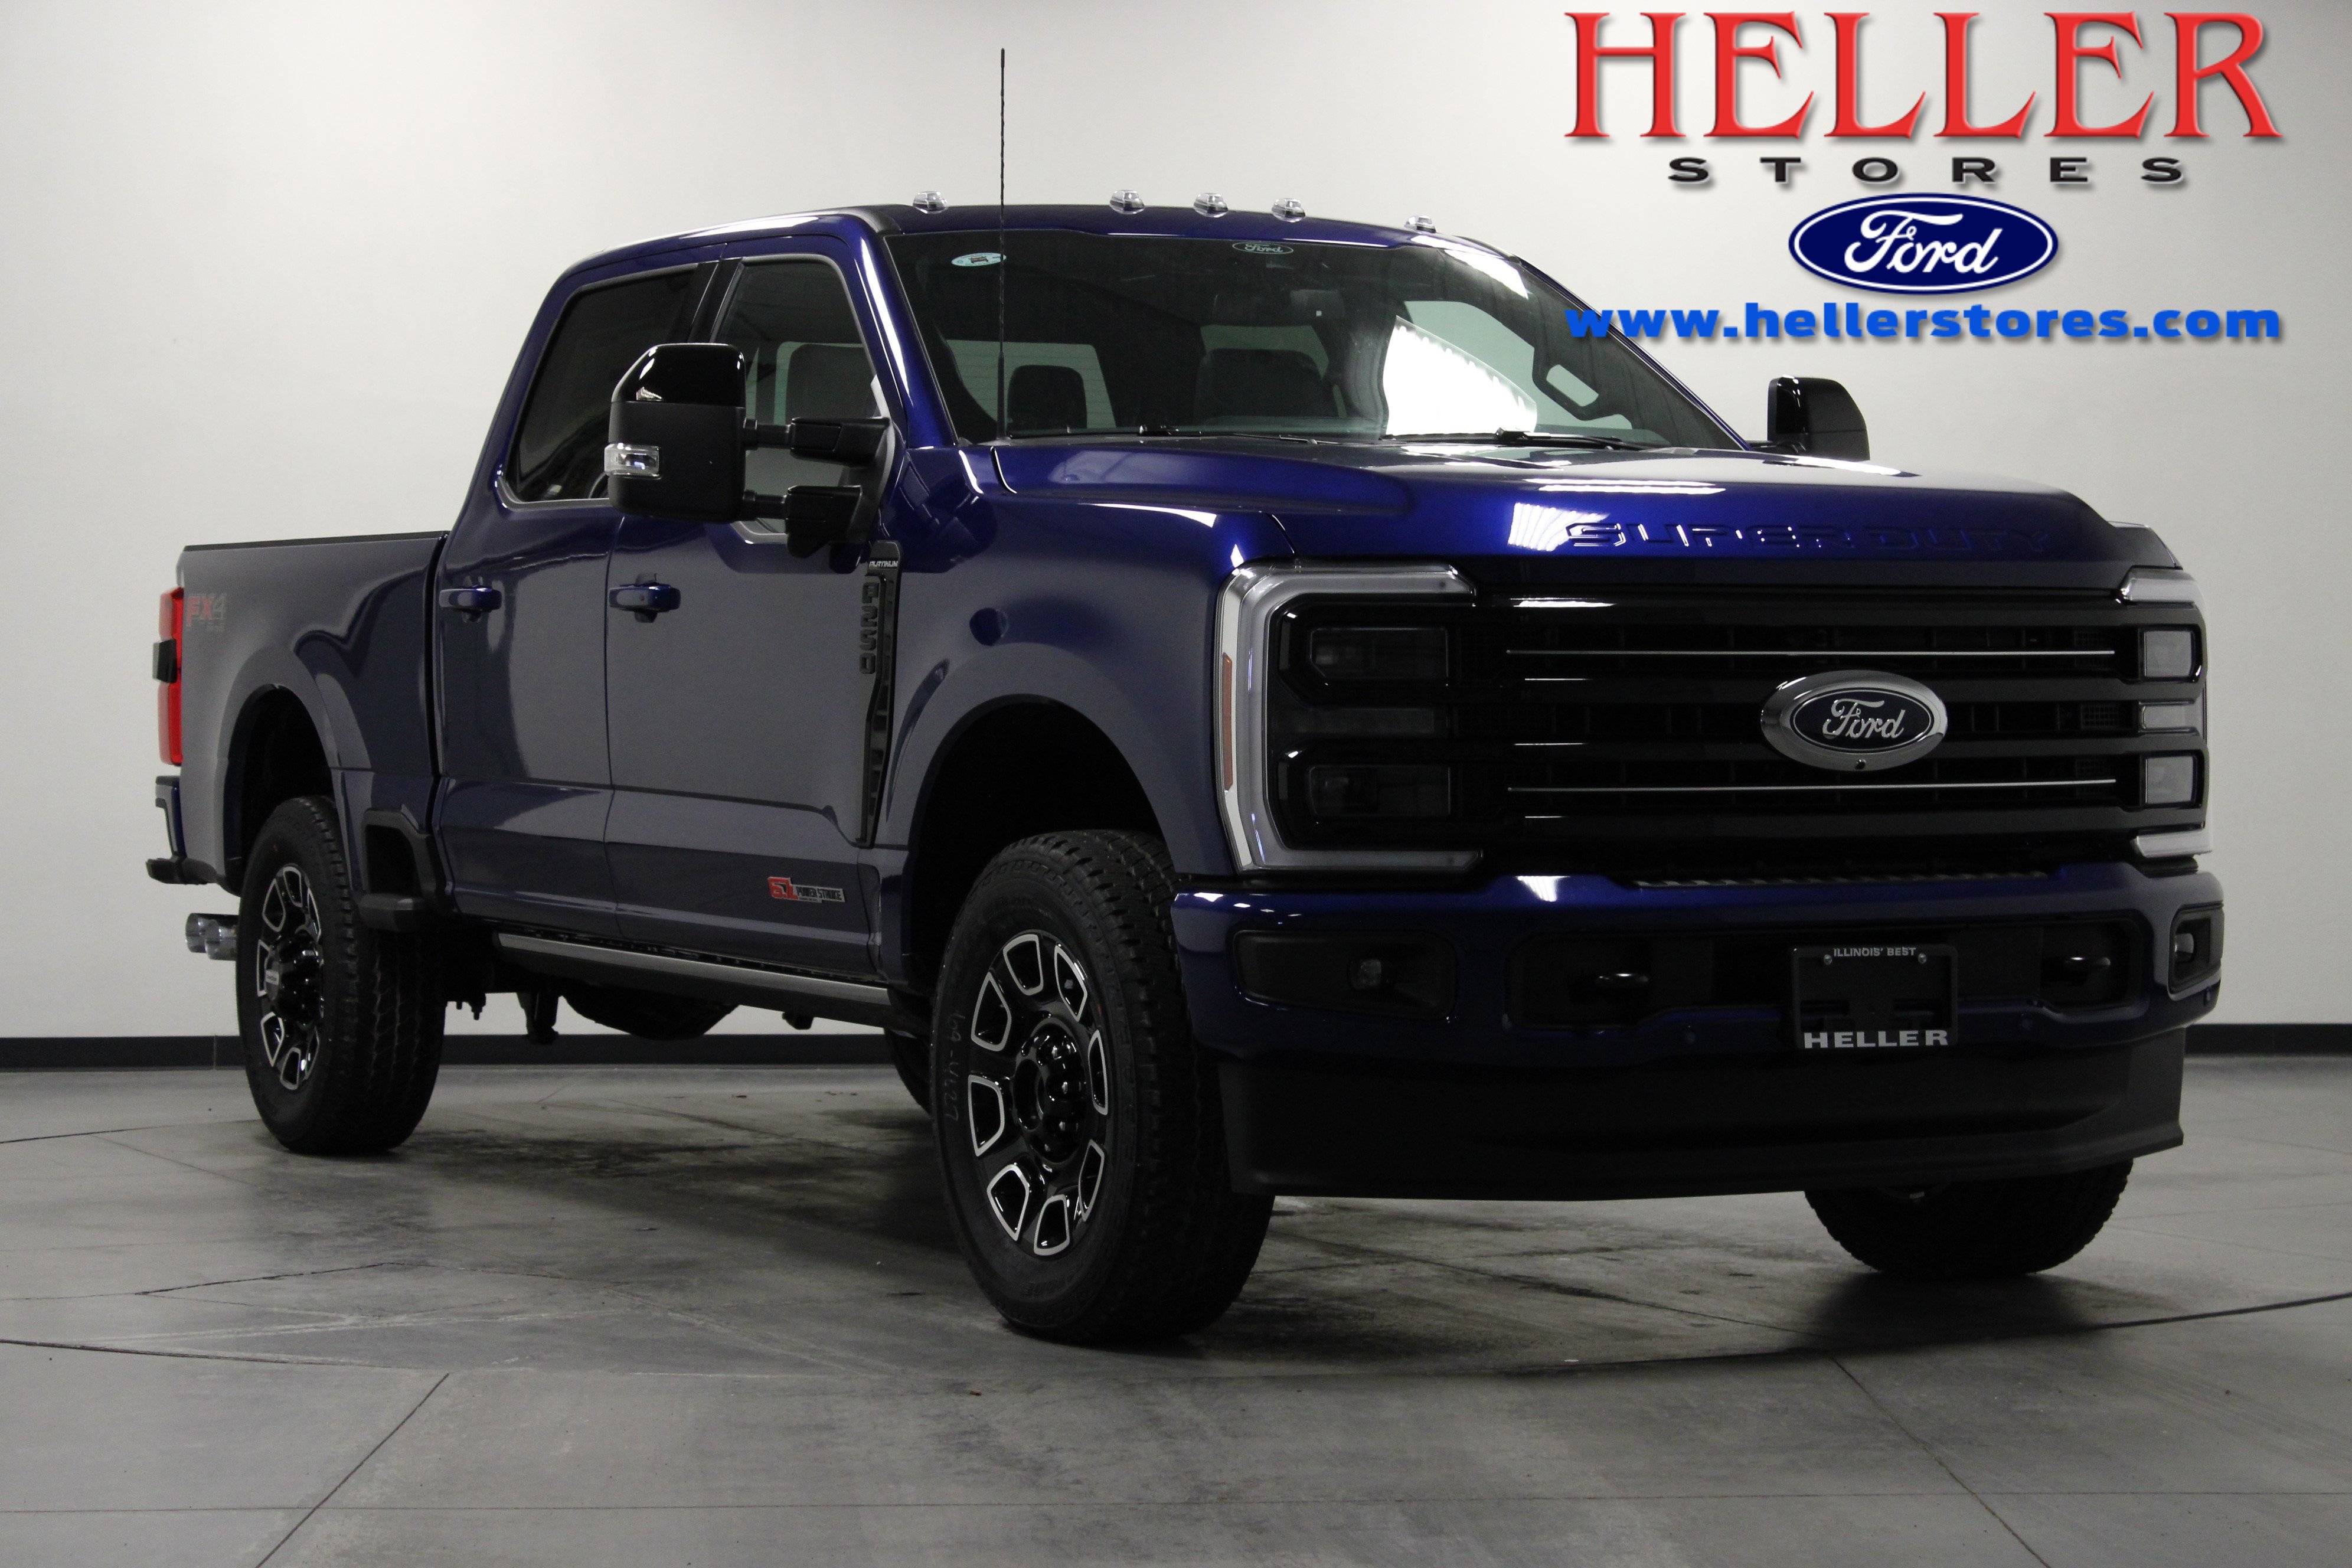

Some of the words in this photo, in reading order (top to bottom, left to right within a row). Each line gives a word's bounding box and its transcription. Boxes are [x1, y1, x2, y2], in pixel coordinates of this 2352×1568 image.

[1244, 243, 1283, 253] Ford
[1566, 522, 1854, 548] SUPER
[186, 593, 227, 628] FX4
[1822, 698, 1906, 739] Ford
[1834, 947, 1883, 957] ILLINOIS'
[1887, 947, 1916, 956] BEST
[1804, 1030, 1948, 1048] HELLER
